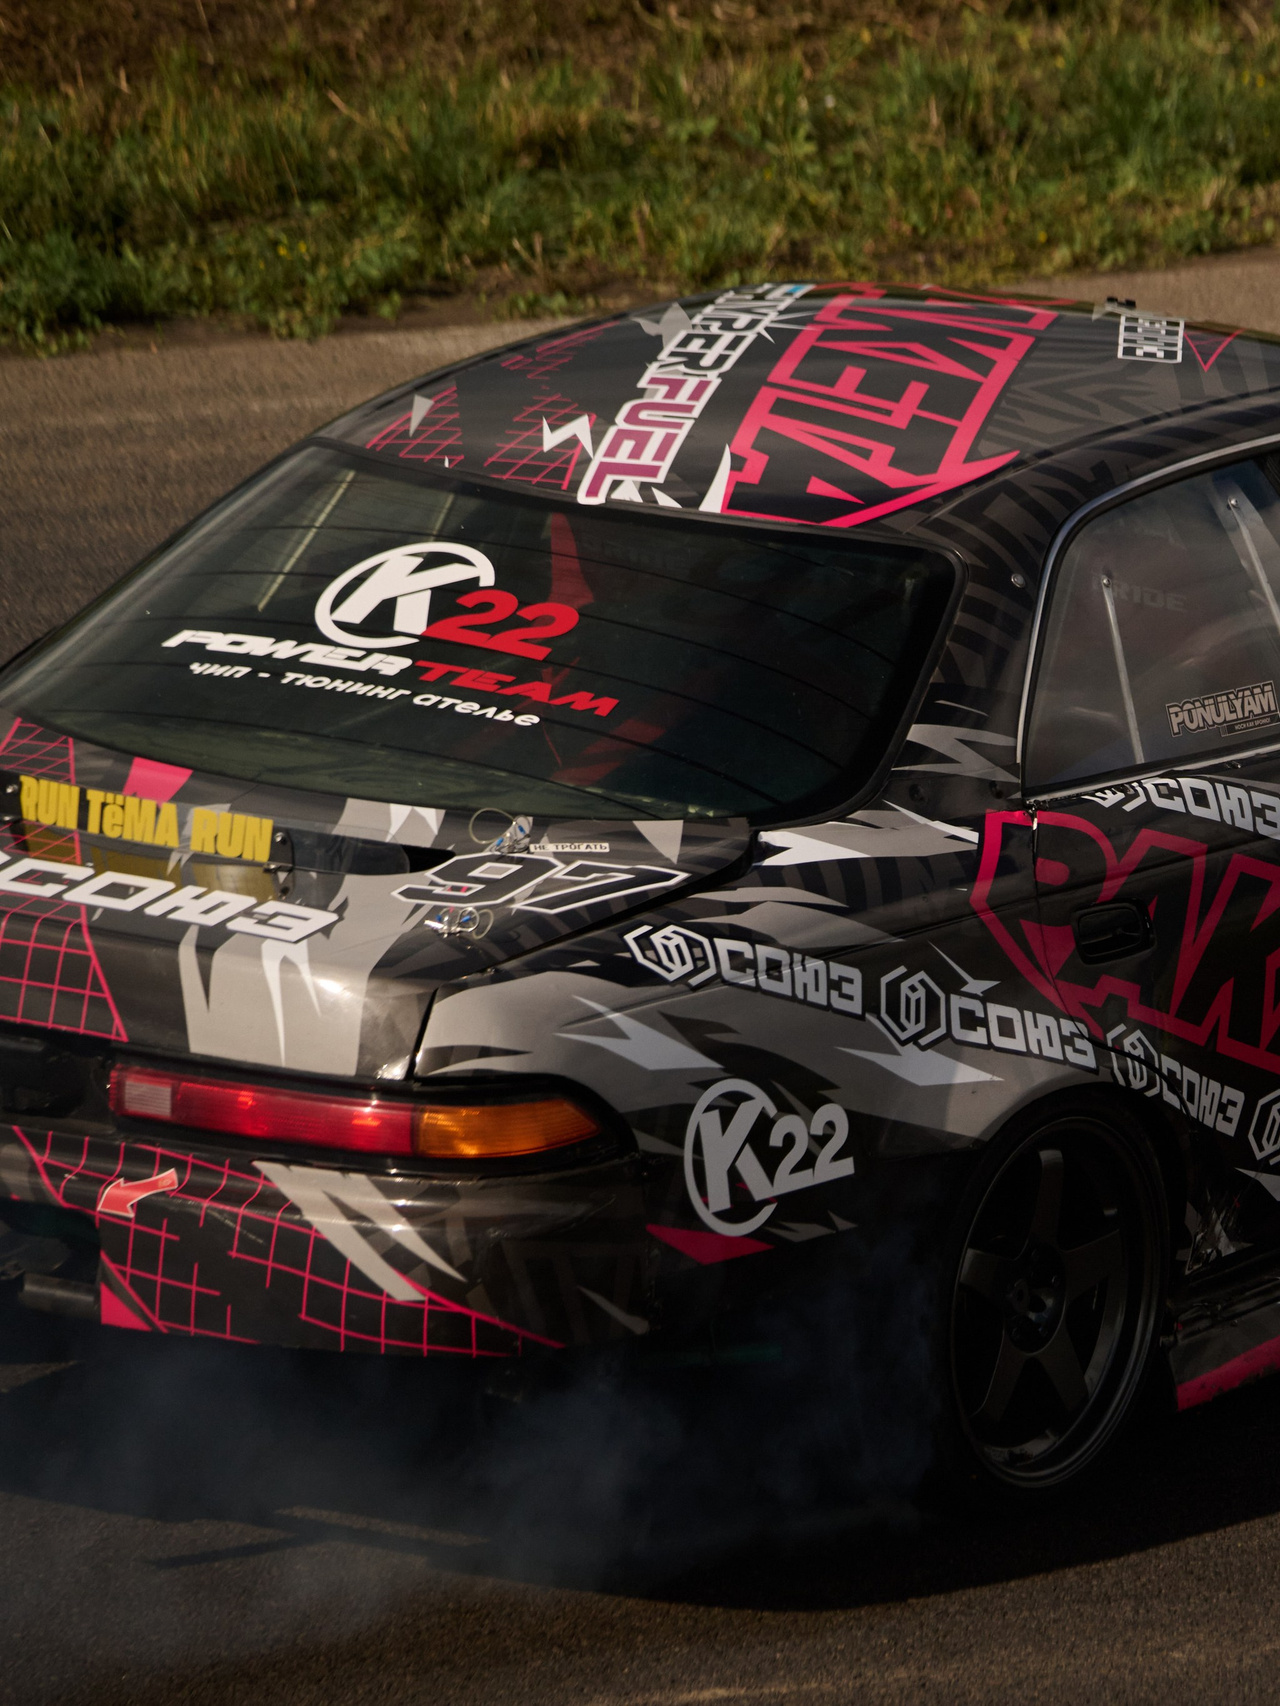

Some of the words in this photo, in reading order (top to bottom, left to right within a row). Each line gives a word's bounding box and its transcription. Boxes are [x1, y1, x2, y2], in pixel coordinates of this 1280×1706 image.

[314, 542, 580, 661] K22
[1168, 683, 1278, 734] PONULYAM
[19, 774, 80, 830] RUN
[189, 807, 274, 863] RUN
[390, 851, 693, 915] 97
[713, 937, 864, 1016] СОЮЗ
[684, 1078, 856, 1237] K22
